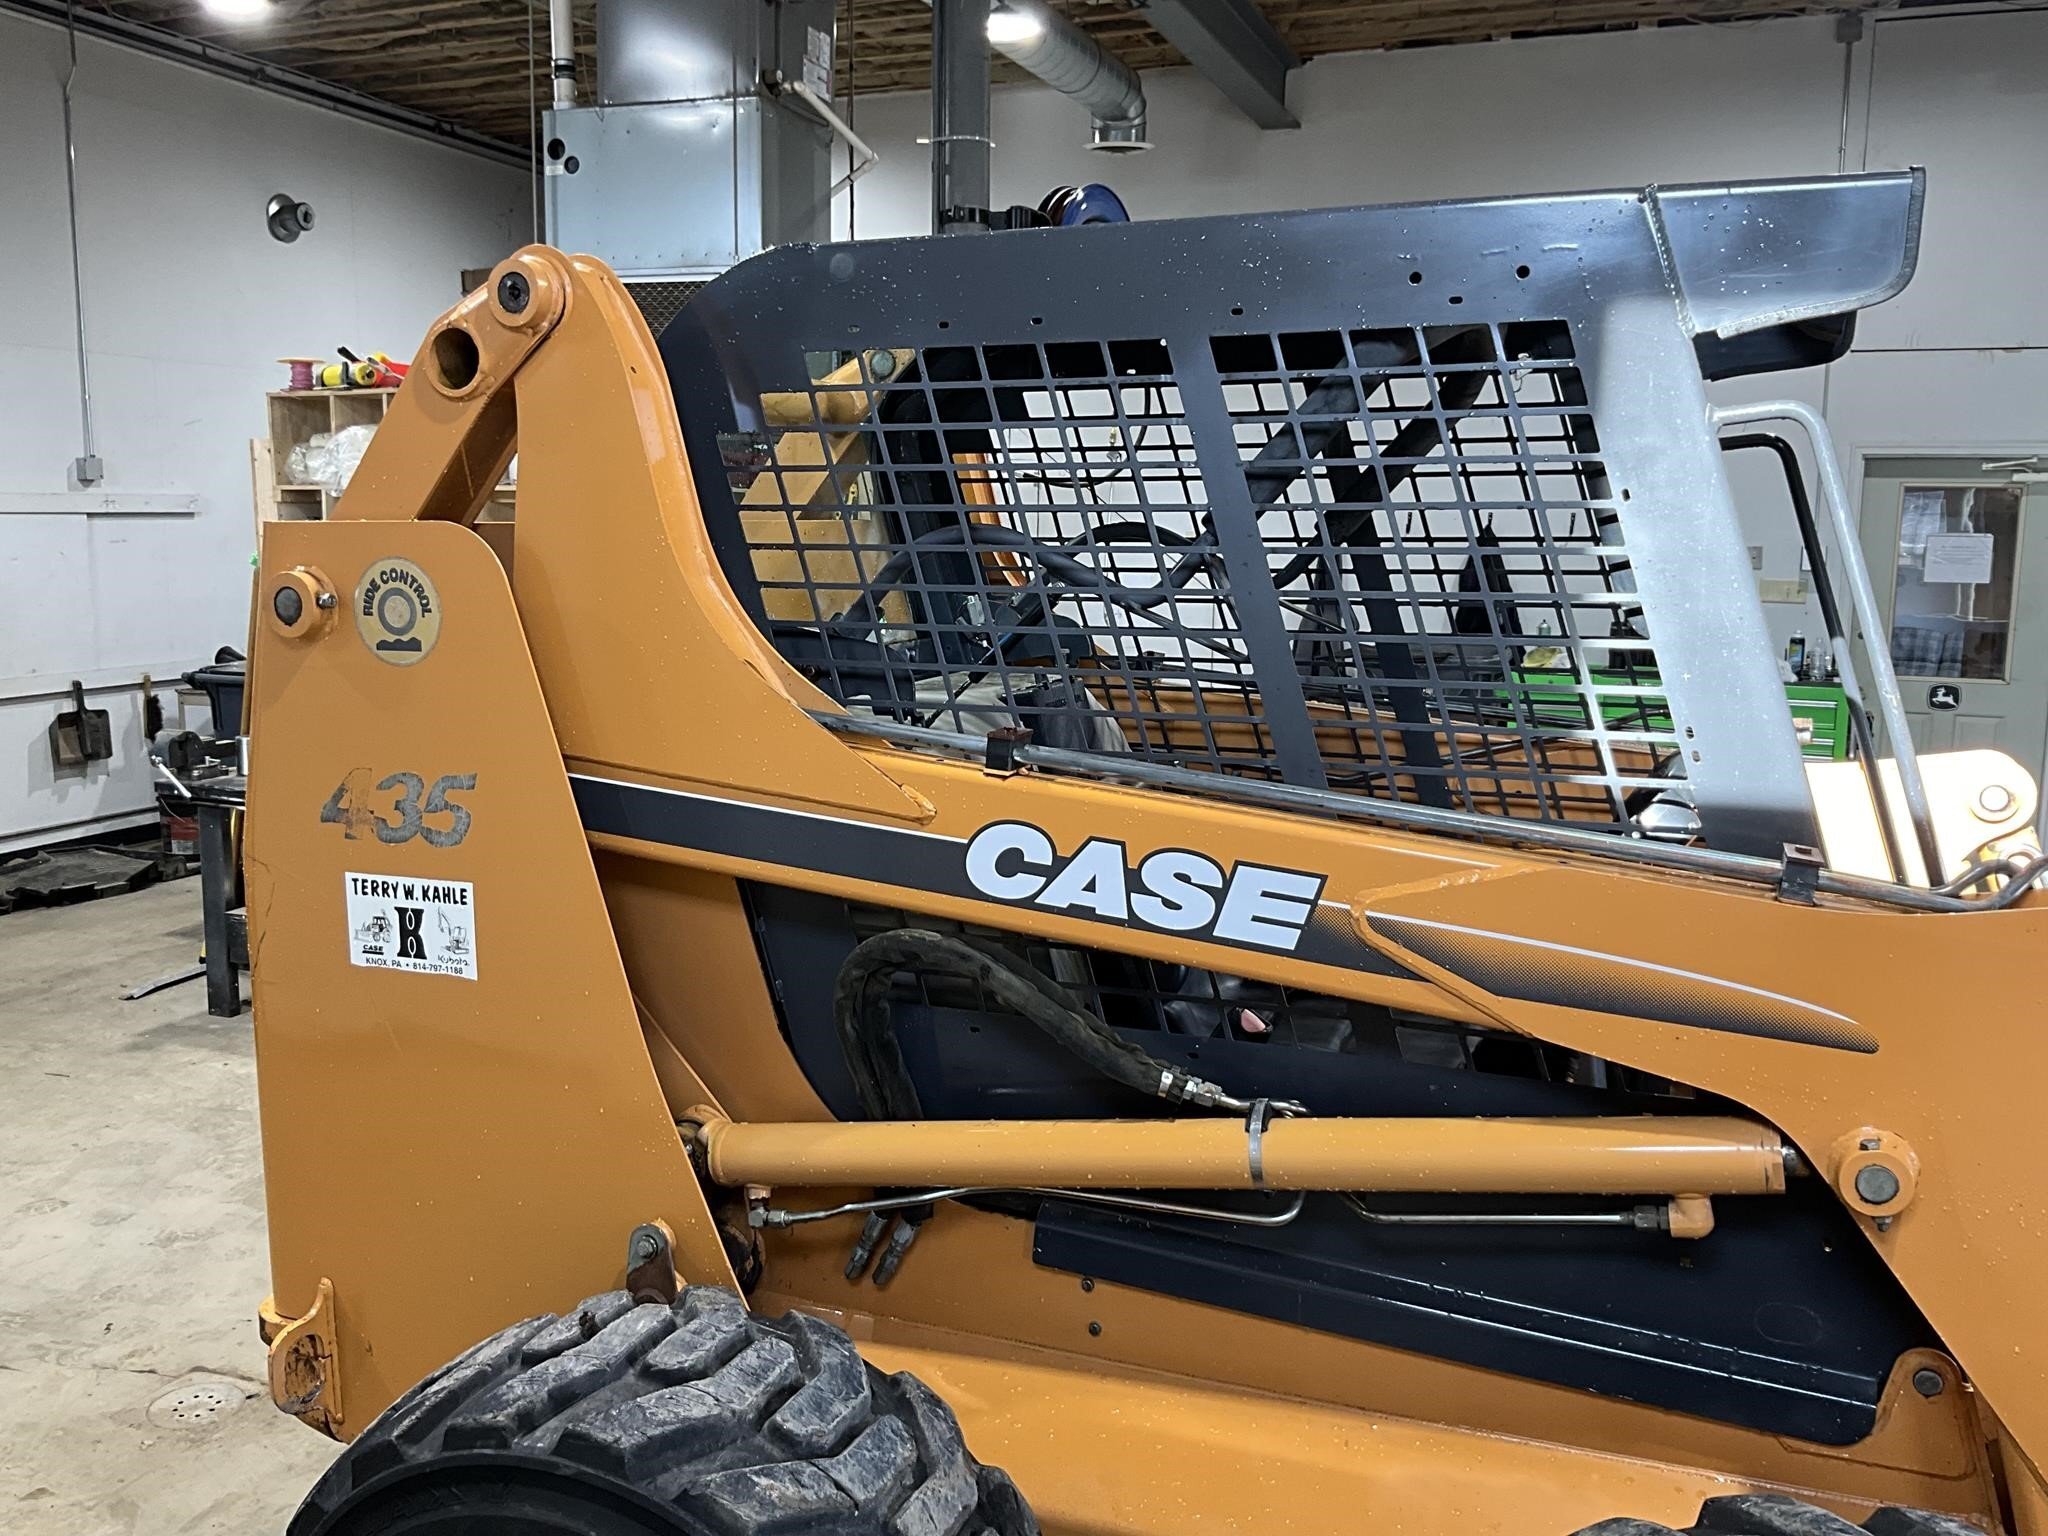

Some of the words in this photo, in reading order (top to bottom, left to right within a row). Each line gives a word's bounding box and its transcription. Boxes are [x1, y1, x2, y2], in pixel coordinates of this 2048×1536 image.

[363, 577, 381, 616] RIDE
[380, 567, 432, 618] CONTROL
[320, 768, 477, 848] 435
[352, 878, 398, 899] TERRY
[403, 883, 419, 901] W.
[422, 884, 468, 906] KAHLE
[965, 823, 1321, 950] CASE
[363, 944, 384, 952] CASE
[391, 960, 402, 968] PA
[413, 962, 463, 975] 814-797-1188
